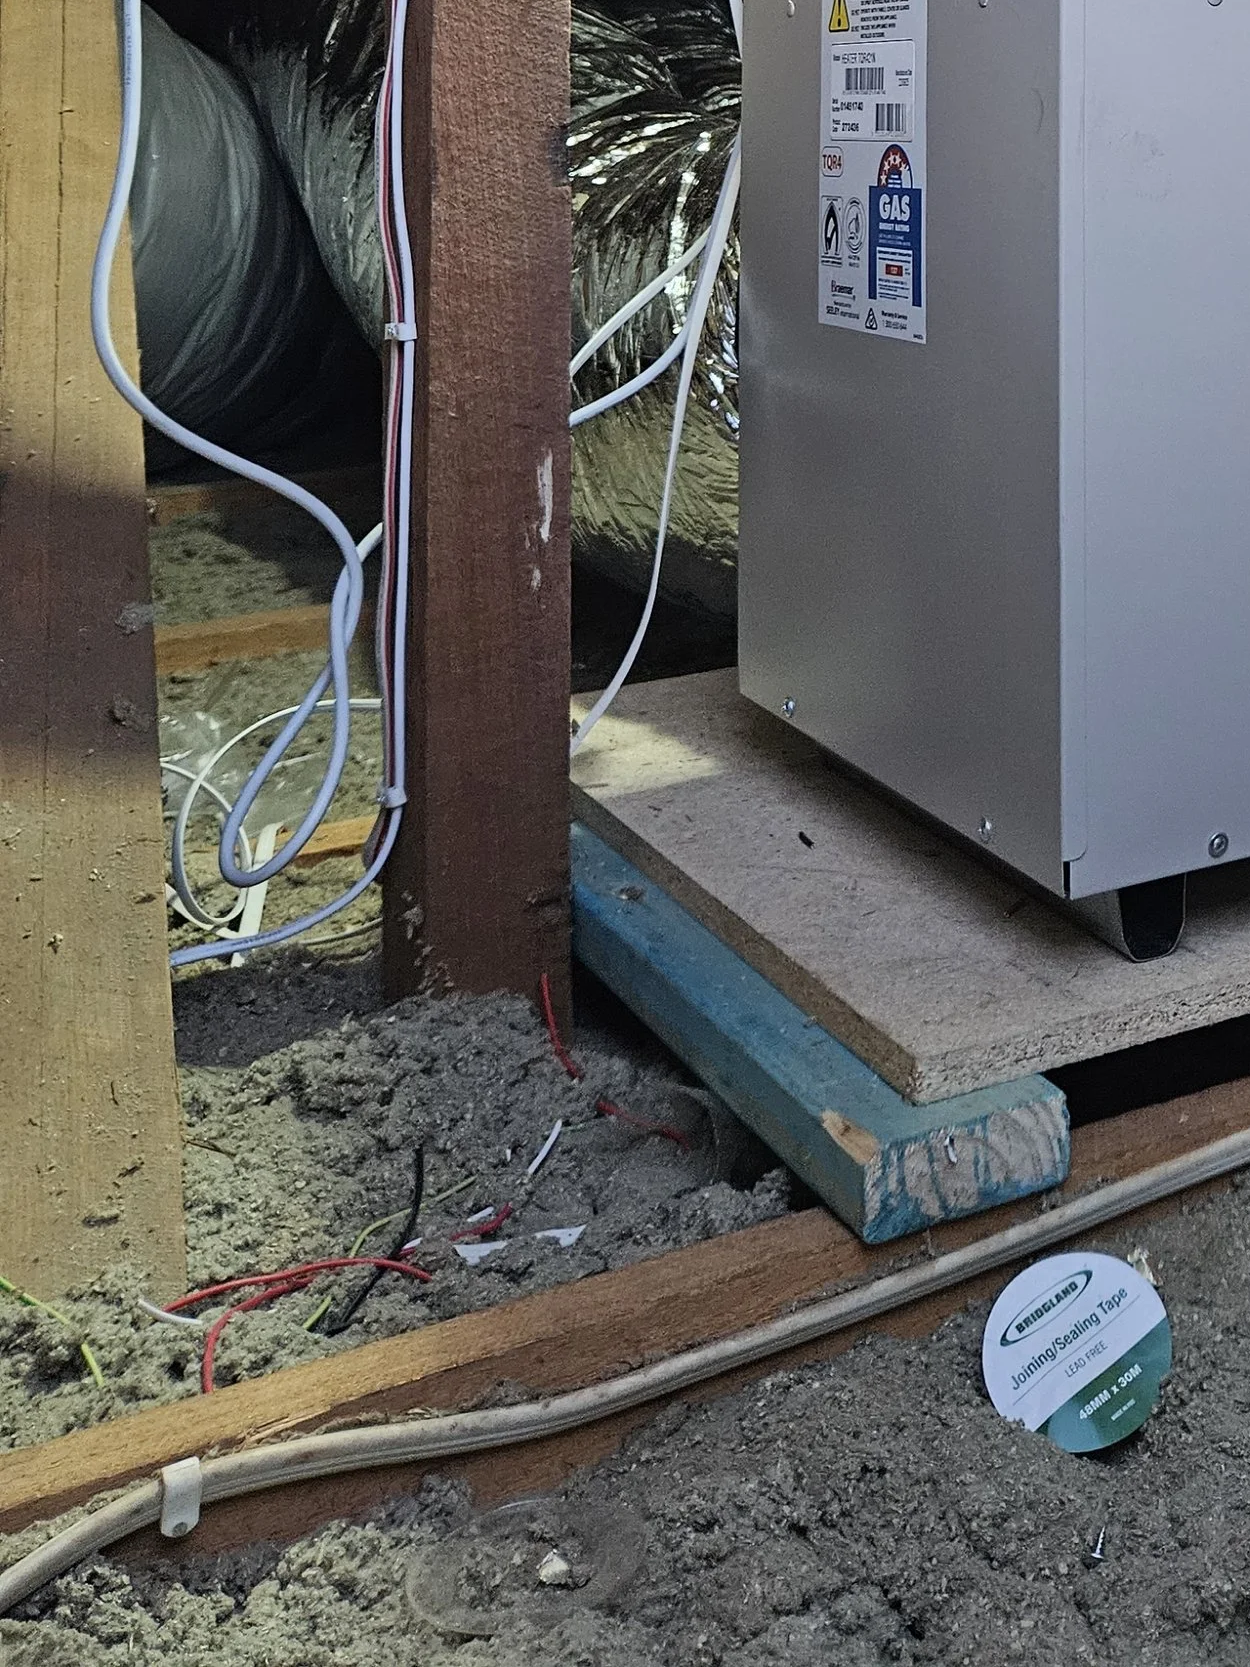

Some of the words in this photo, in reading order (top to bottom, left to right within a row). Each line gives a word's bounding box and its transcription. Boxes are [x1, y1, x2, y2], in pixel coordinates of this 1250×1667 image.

[822, 154, 842, 171] TQR4
[879, 193, 911, 222] GAS
[1015, 1281, 1079, 1334] BRIDGLAND
[1011, 1313, 1101, 1391] Joining/Sealing
[1097, 1287, 1128, 1316] Tape
[1064, 1358, 1087, 1378] LEAD
[1086, 1340, 1108, 1363] FREE
[1079, 1389, 1111, 1421] 48MM
[1111, 1385, 1120, 1395] x
[1117, 1363, 1143, 1388] 30M
